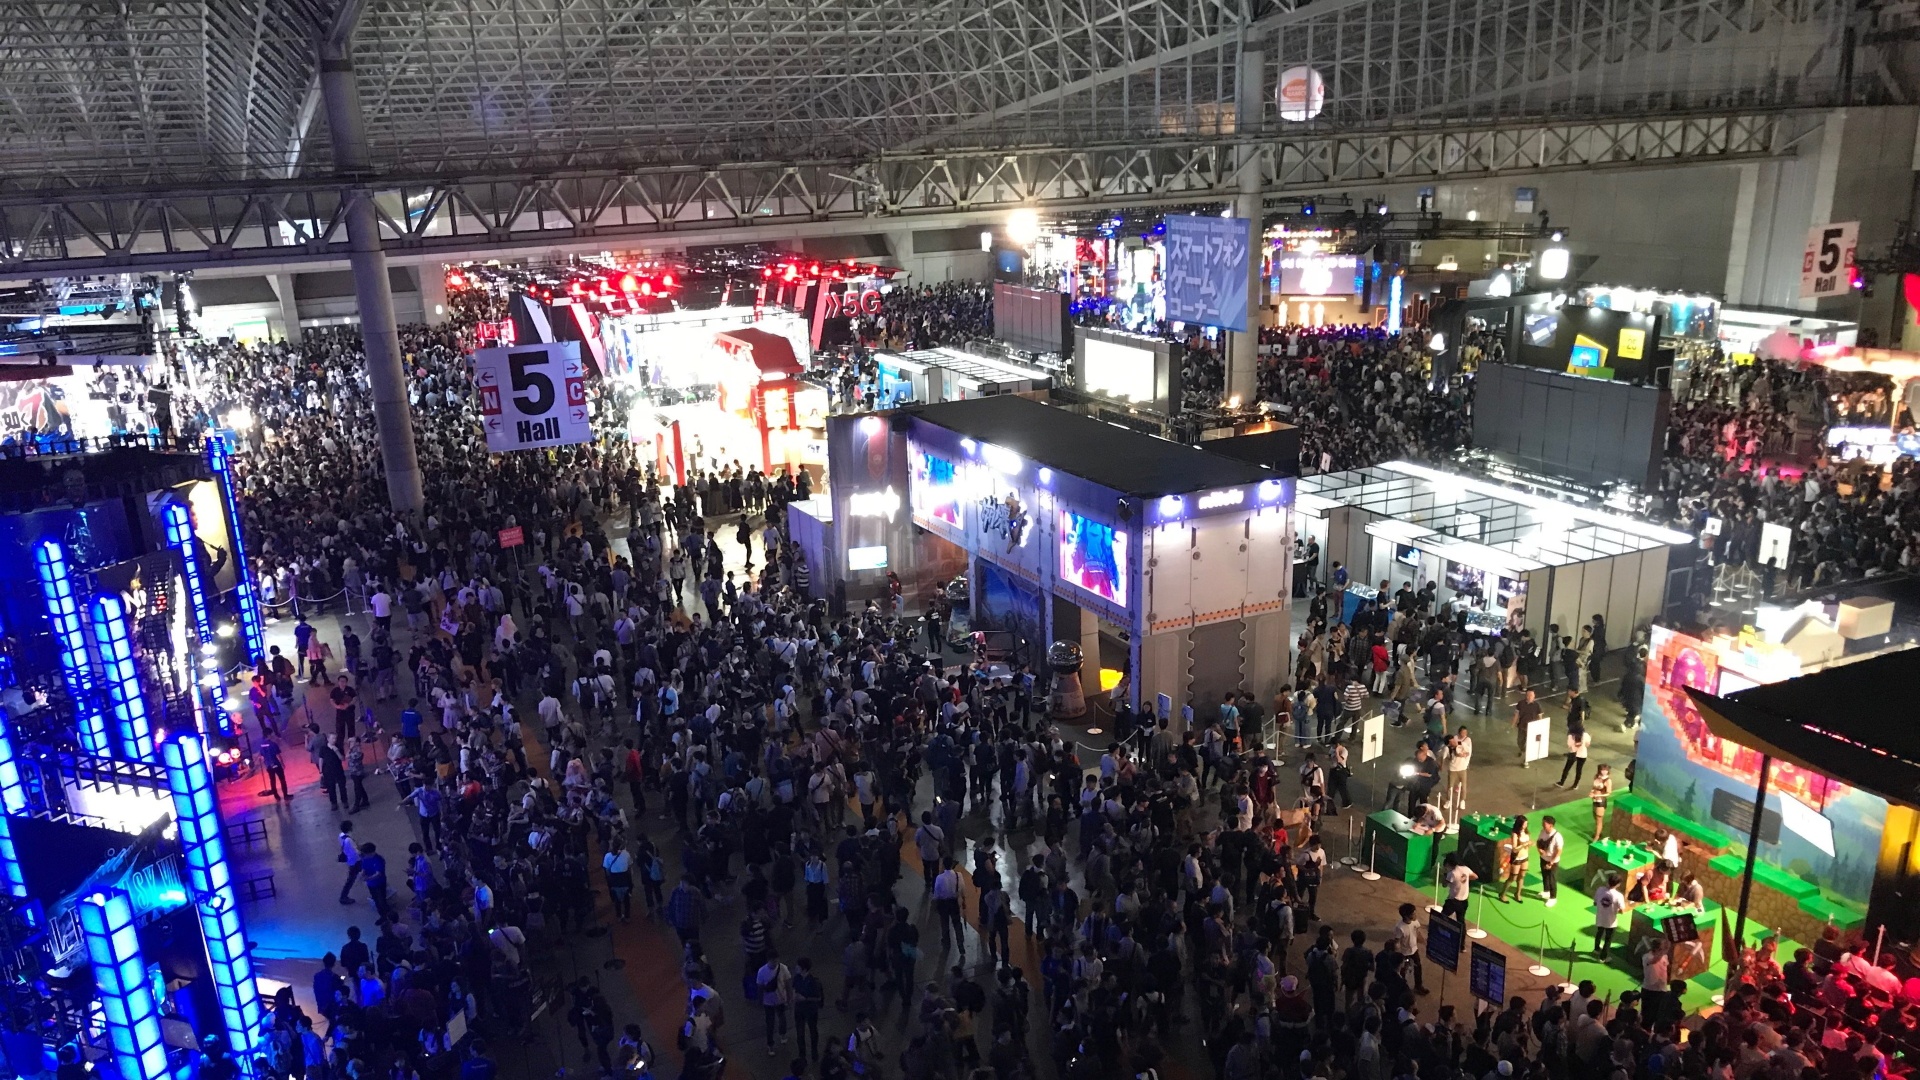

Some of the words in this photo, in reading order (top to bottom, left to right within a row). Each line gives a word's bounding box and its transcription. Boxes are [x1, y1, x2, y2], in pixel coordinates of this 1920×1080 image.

[1171, 234, 1245, 267] スマートフォン
[1819, 228, 1843, 274] 5
[1170, 264, 1217, 298] ゲーム
[1814, 276, 1836, 293] Hall
[843, 289, 881, 317] 5G
[1170, 298, 1220, 320] コーナー
[508, 350, 555, 415] 5
[570, 382, 582, 401] C
[483, 391, 498, 410] N
[517, 417, 561, 443] Hall
